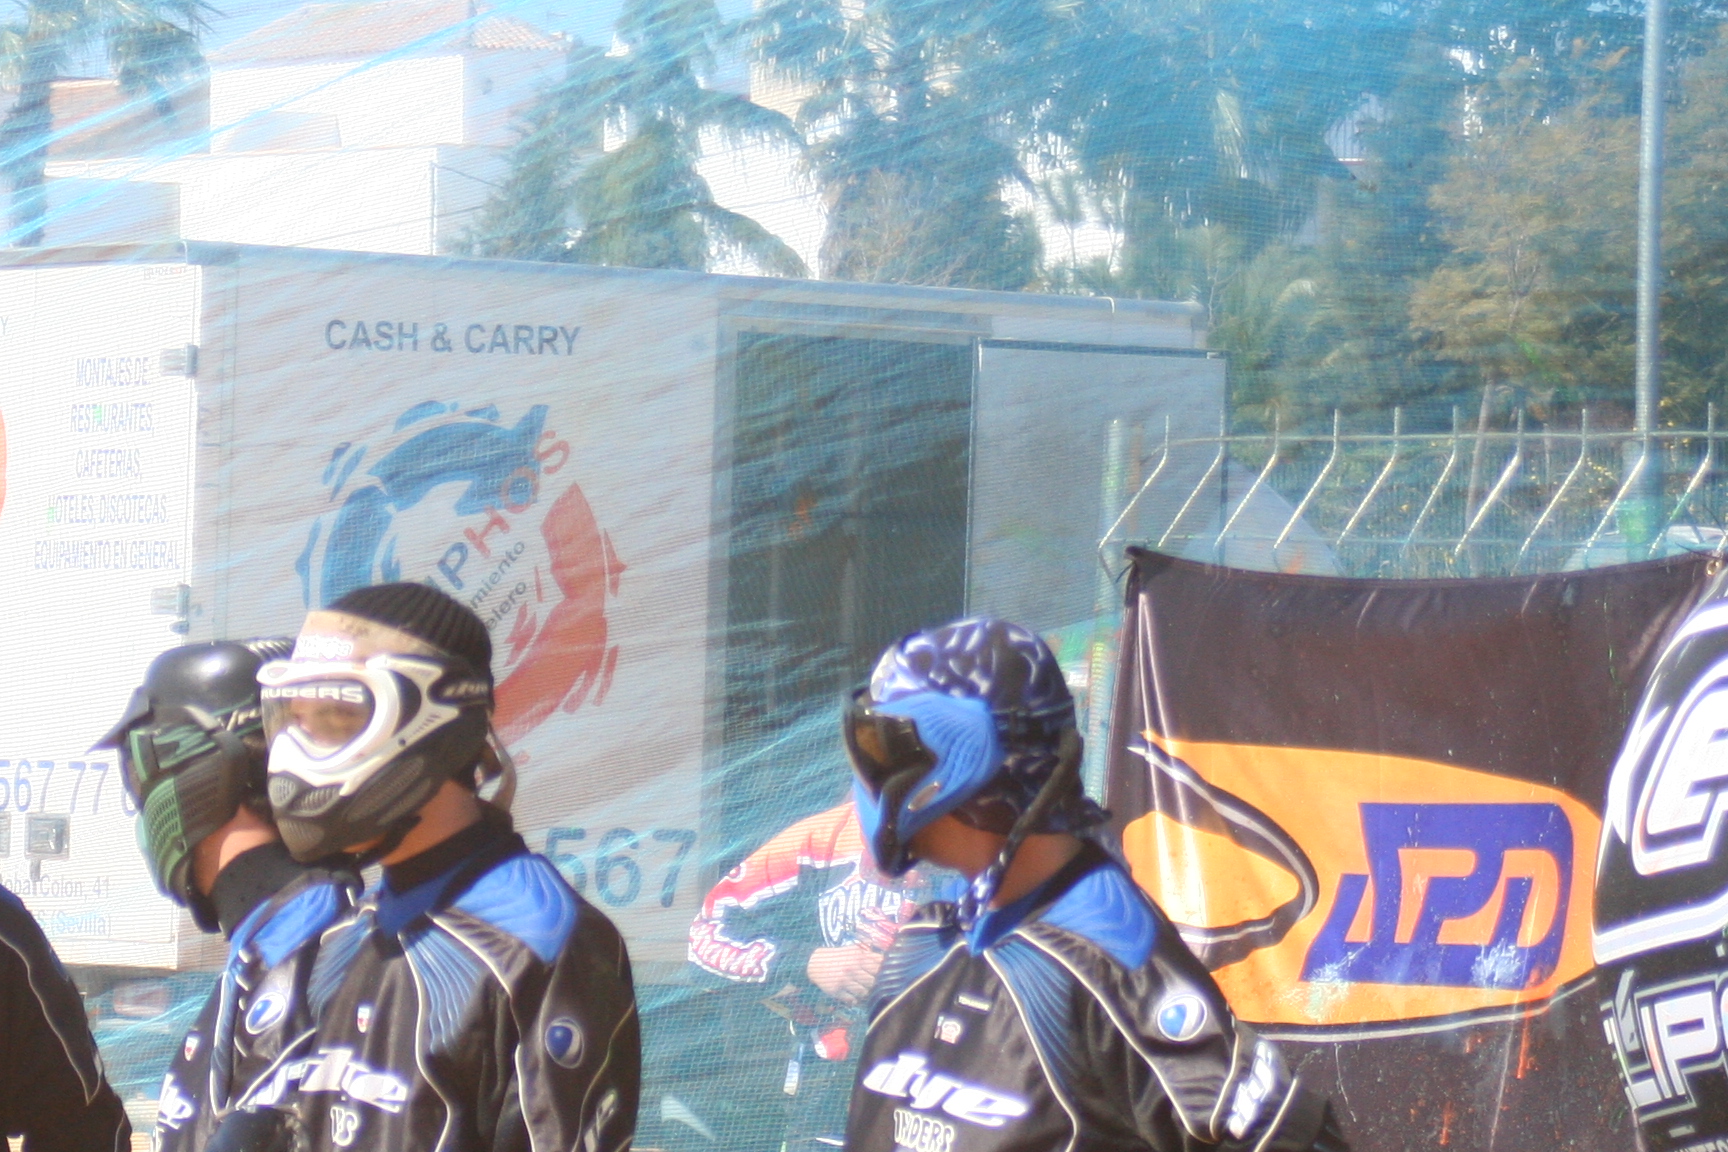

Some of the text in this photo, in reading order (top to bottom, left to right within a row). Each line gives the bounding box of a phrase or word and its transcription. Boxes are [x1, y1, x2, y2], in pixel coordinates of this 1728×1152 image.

[324, 318, 582, 356] CASH & CARRY
[68, 761, 110, 815] 77
[545, 826, 698, 909] 567
